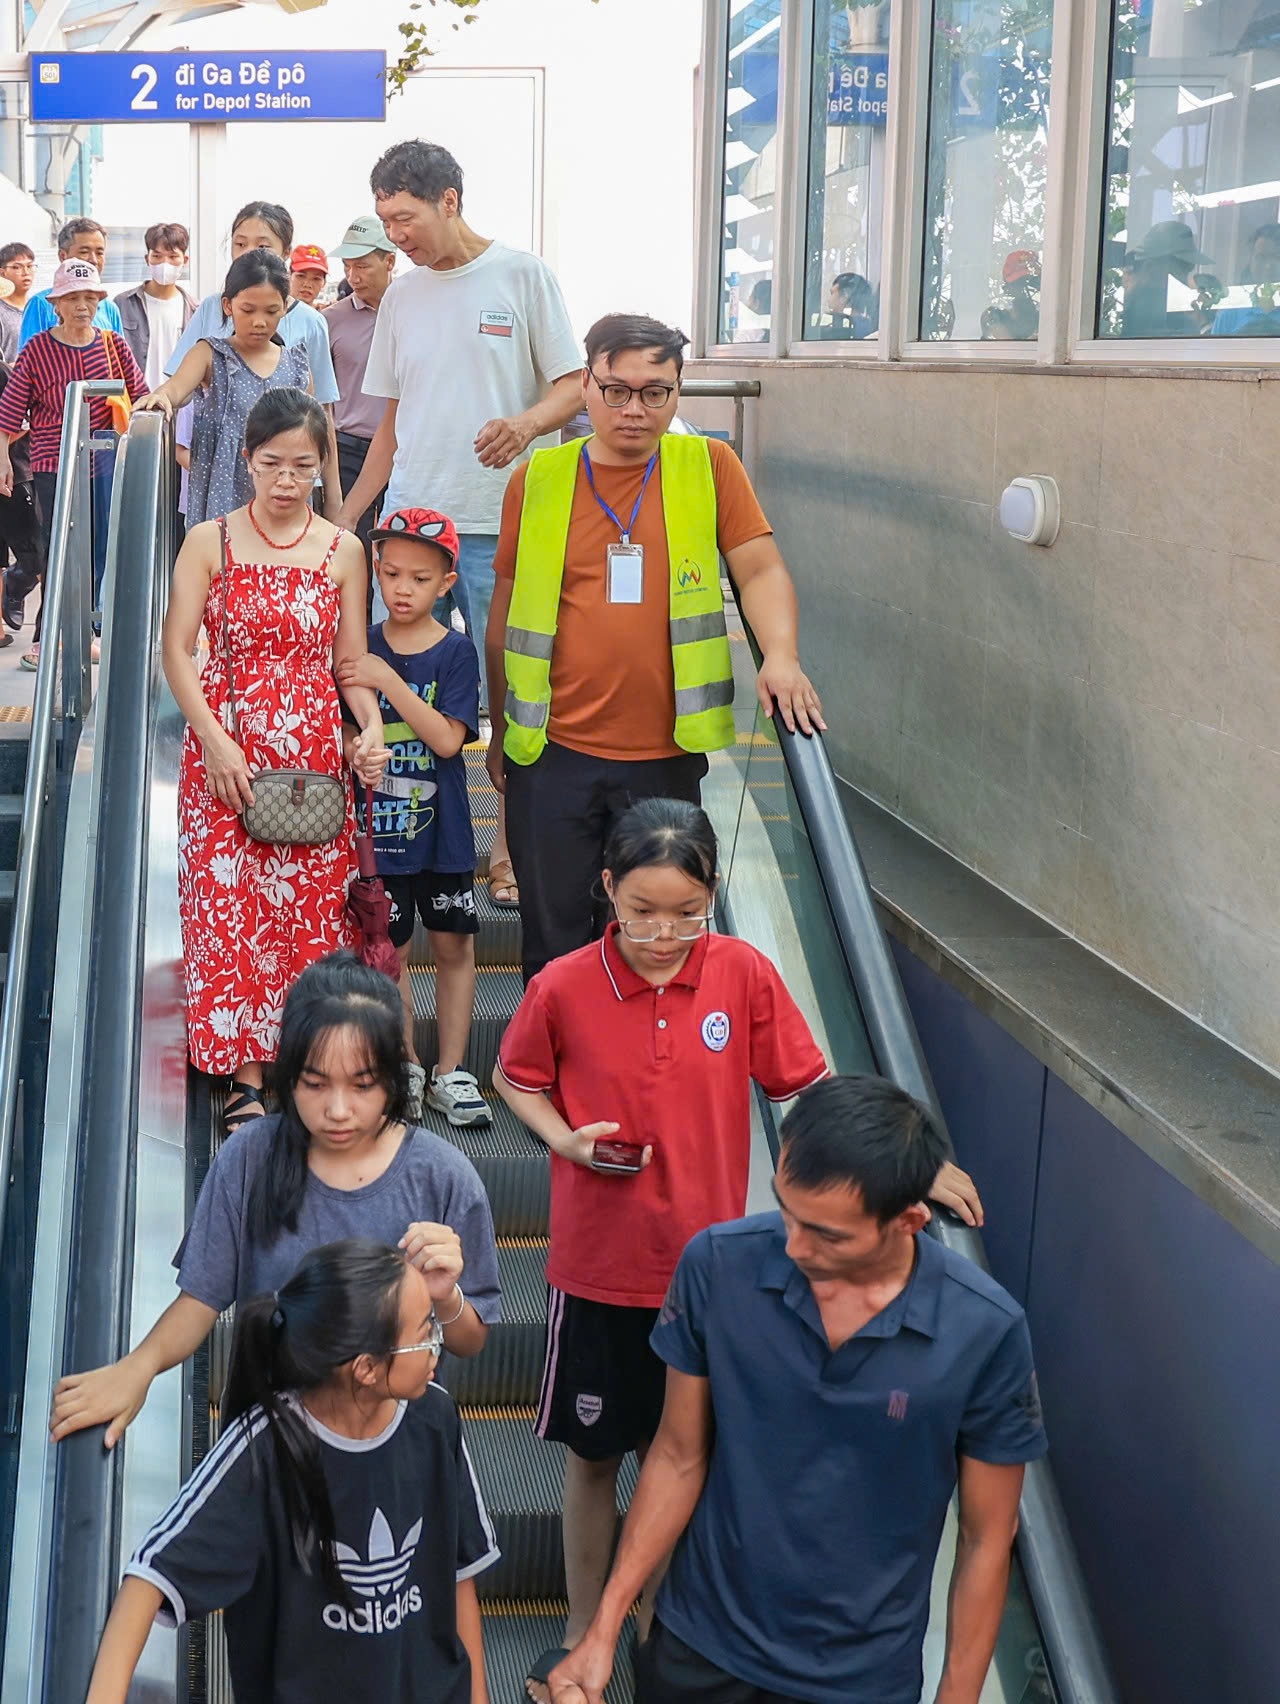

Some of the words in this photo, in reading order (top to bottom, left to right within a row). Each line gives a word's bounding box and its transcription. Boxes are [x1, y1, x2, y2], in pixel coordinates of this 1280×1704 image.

[130, 63, 158, 110] 2
[175, 63, 195, 85] đi
[202, 63, 232, 85] Ga
[239, 59, 273, 85] Đề
[278, 63, 306, 90] pô
[175, 93, 200, 110] for
[204, 92, 251, 112] Depot
[255, 91, 311, 109] Station
[75, 268, 89, 278] 82
[322, 1584, 423, 1634] adidas
